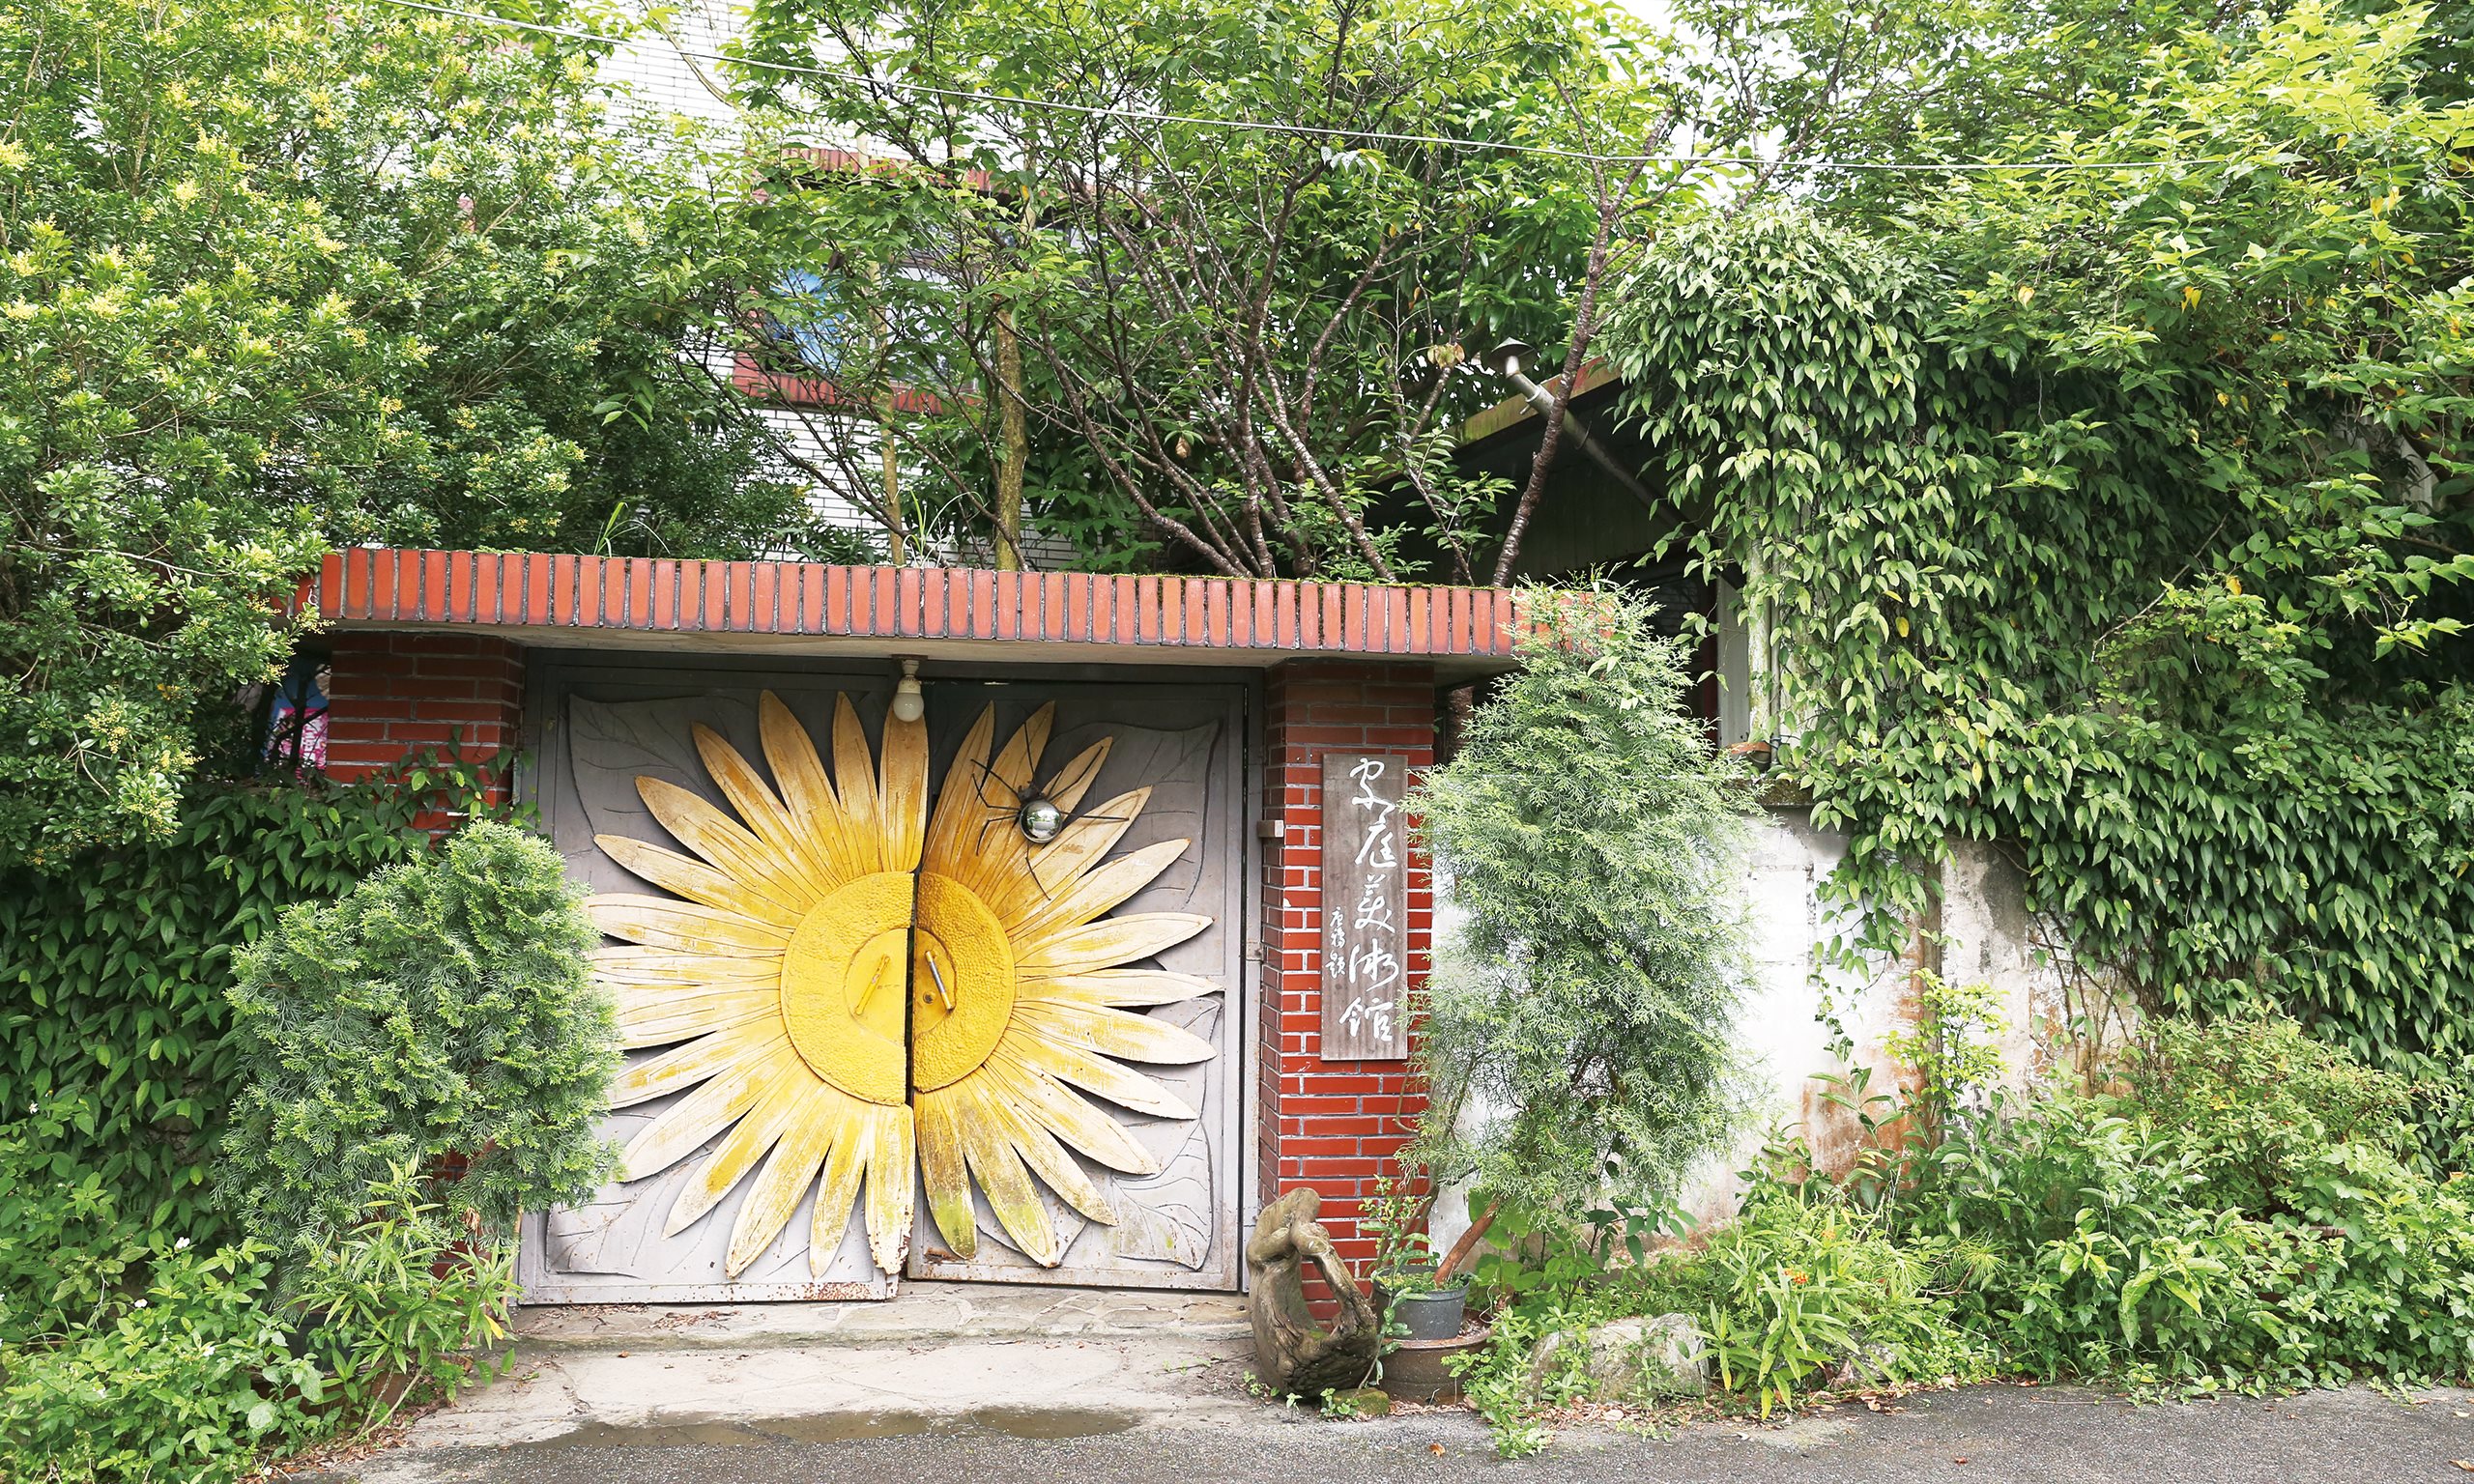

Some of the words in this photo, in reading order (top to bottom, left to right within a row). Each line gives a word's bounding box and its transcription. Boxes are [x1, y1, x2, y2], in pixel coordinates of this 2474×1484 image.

[1338, 757, 1398, 1042] 家庭美術館
